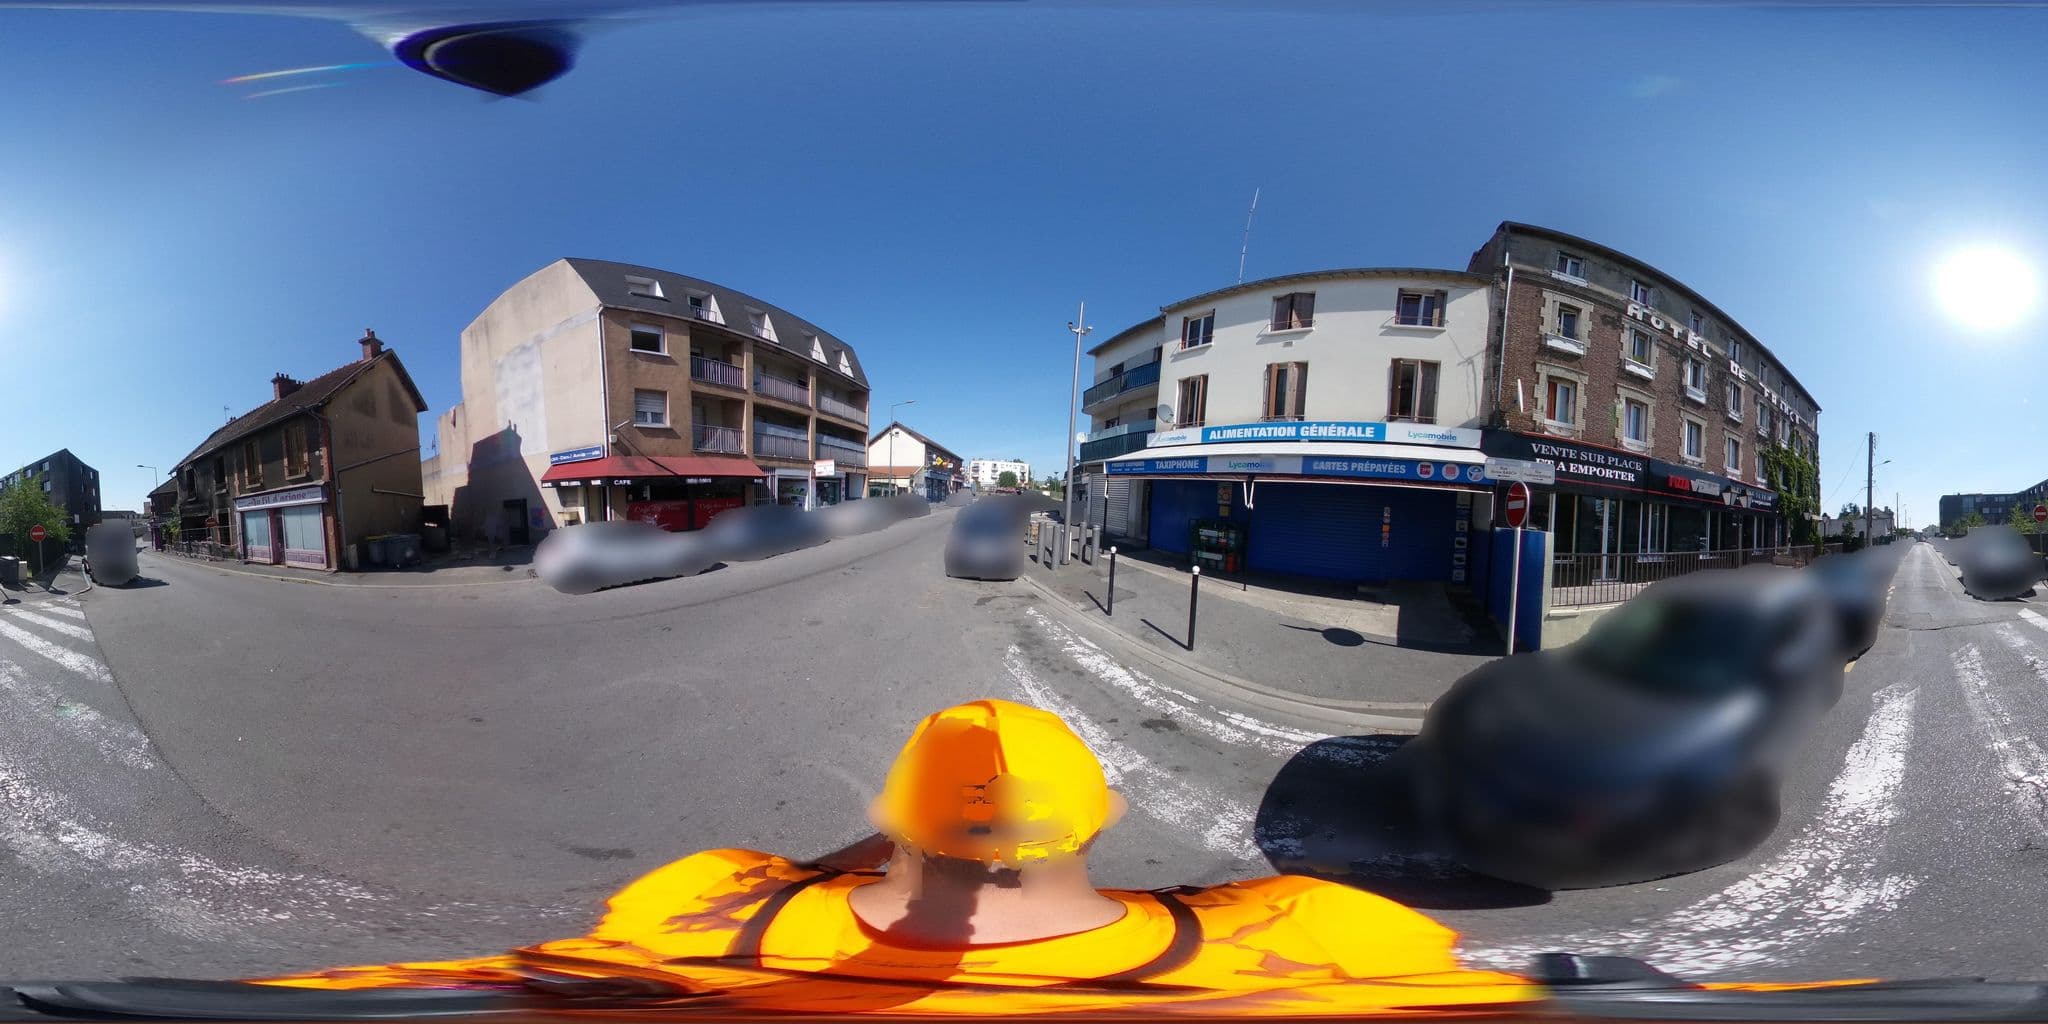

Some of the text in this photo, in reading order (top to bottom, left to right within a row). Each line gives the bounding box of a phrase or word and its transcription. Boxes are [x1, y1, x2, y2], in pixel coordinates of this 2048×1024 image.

[1209, 424, 1374, 440] ALIMENTATION GÉNÉRALE
[1408, 431, 1456, 441] Lycamobile
[1156, 459, 1199, 469] TAXIPHONE
[1532, 443, 1642, 471] VENTE SUR PLACE
[1313, 461, 1406, 474] CARTES PRÉPAYÉES
[1556, 462, 1566, 471] A
[1569, 464, 1635, 482] EMPORTER
